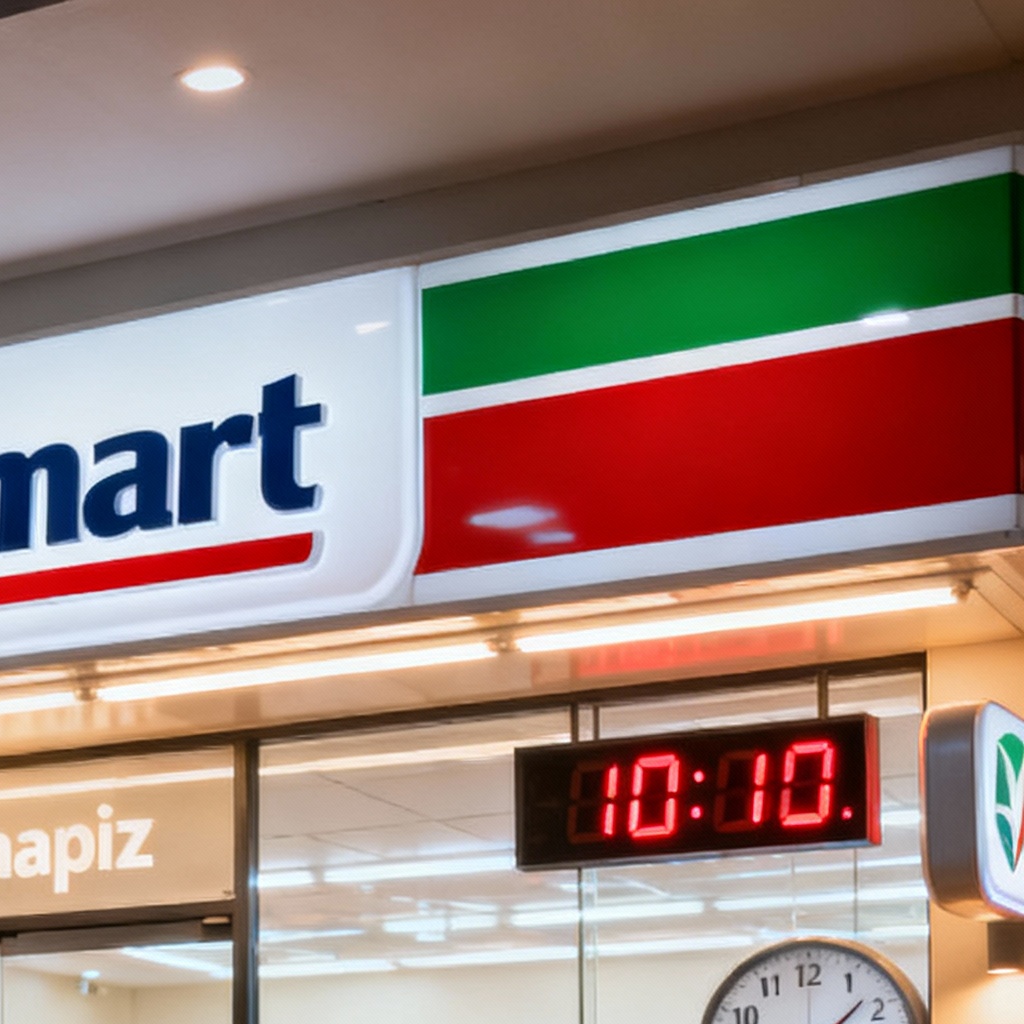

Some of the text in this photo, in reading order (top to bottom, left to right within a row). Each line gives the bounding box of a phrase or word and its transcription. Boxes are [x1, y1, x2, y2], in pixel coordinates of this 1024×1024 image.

[761, 974, 780, 997] 11
[795, 963, 822, 988] 12
[844, 973, 853, 993] 1
[870, 999, 885, 1021] 2
